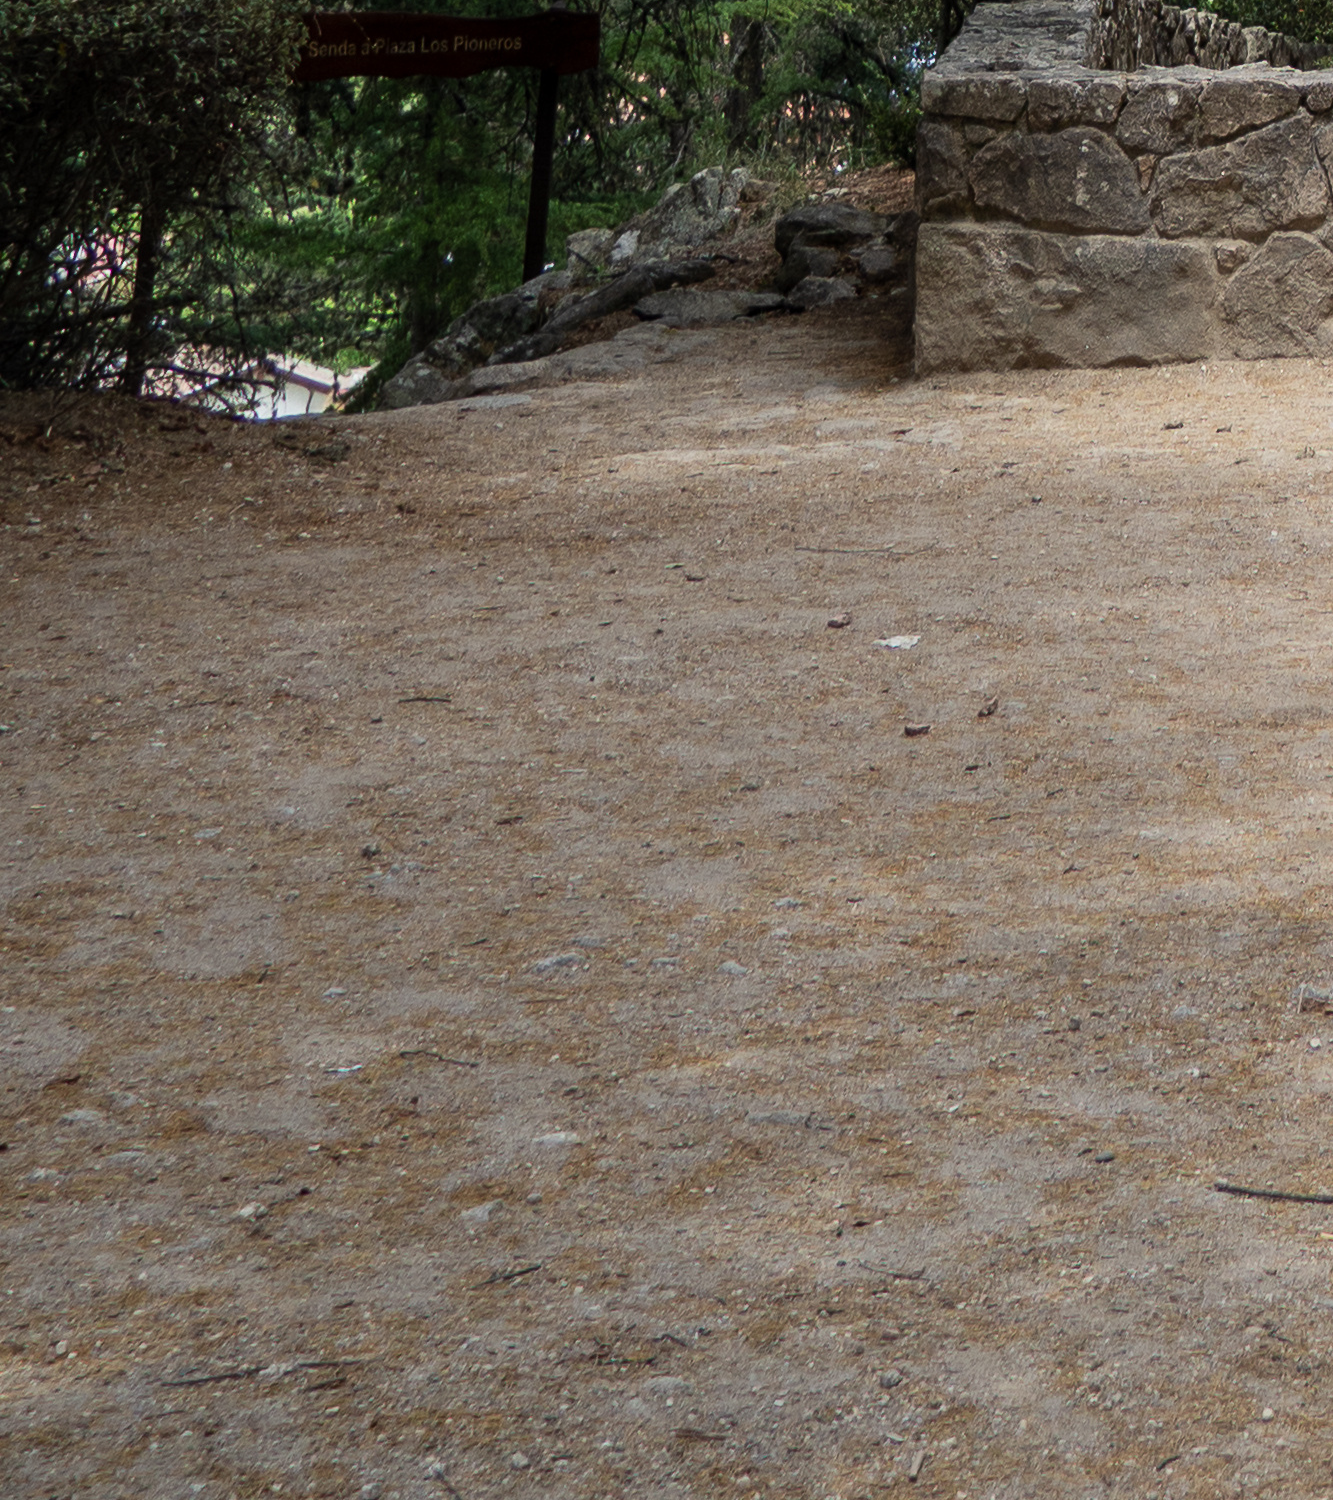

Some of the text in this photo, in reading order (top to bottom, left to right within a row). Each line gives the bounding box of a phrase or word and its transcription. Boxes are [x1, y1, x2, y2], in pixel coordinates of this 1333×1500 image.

[308, 40, 357, 58] Senda
[375, 37, 415, 55] Plaza
[421, 36, 449, 53] Los
[454, 35, 522, 52] Pioneros
